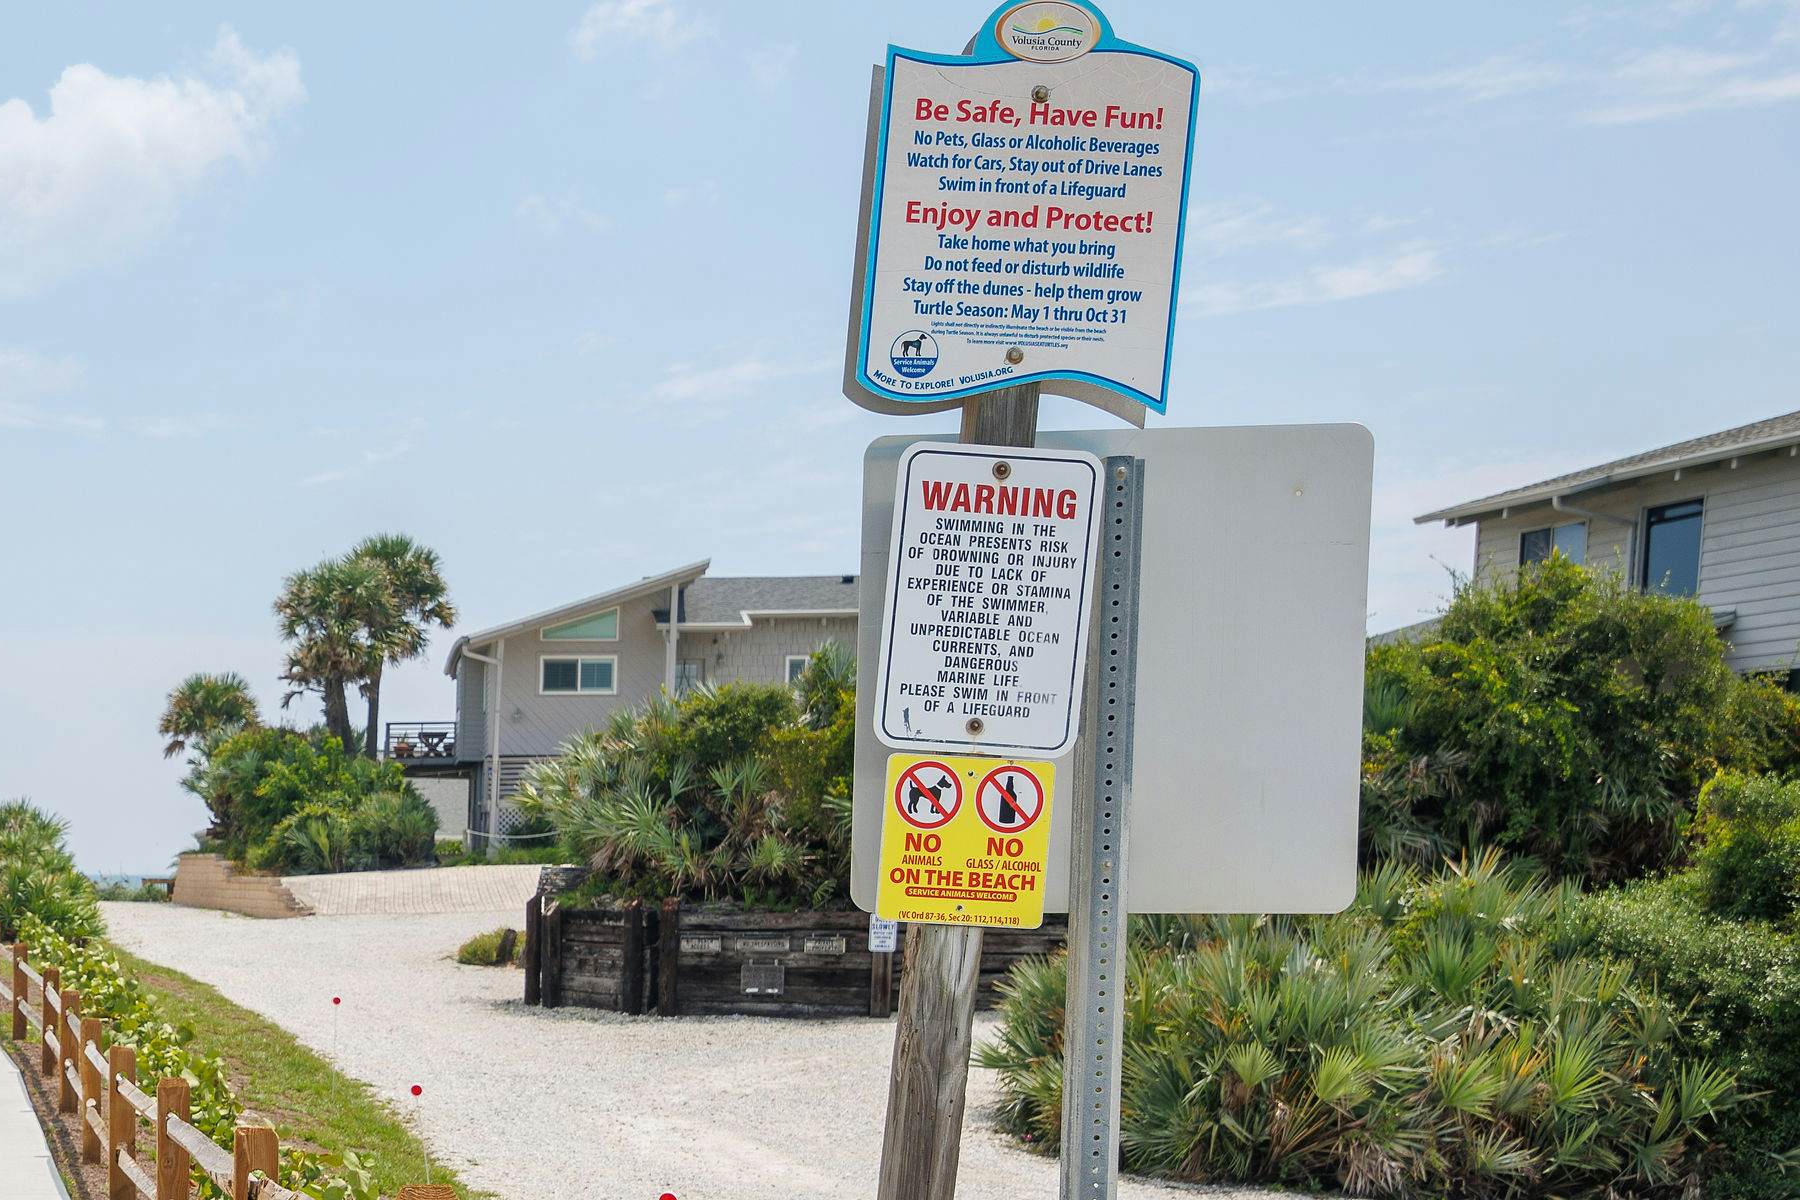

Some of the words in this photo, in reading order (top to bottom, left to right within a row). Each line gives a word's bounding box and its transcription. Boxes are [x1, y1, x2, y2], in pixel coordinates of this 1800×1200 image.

[1012, 36, 1045, 45] Volusia
[1048, 37, 1082, 51] County
[916, 98, 949, 121] Be
[956, 100, 1021, 127] Safe,
[1029, 102, 1097, 128] Have
[1105, 106, 1163, 129] Fun!
[915, 131, 932, 145] No
[936, 131, 968, 149] Pets,
[972, 133, 1005, 148] Glass
[1009, 138, 1023, 148] or
[1025, 135, 1086, 151] Alcoholic
[1089, 137, 1159, 157] Beverages
[908, 153, 948, 168] Watch
[952, 154, 972, 169] for
[974, 155, 1005, 173] Cars,
[1009, 157, 1039, 175] Stay
[1042, 160, 1065, 173] out
[1068, 159, 1083, 173] of
[1085, 160, 1120, 175] Drive
[1123, 161, 1162, 177] Lanes
[939, 176, 975, 191] Swim
[979, 177, 992, 192] in
[995, 178, 1030, 194] front
[1033, 180, 1048, 194] of
[1049, 184, 1057, 195] a
[1061, 181, 1126, 200] Lifeguard
[906, 201, 981, 232] Enjoy
[987, 205, 1039, 228] and
[1046, 207, 1153, 233] Protect!
[938, 234, 968, 249] Take
[972, 235, 1010, 251] home
[1014, 238, 1049, 253] what
[1051, 243, 1076, 257] you
[1079, 240, 1115, 259] bring
[925, 256, 942, 270] Do
[945, 259, 969, 271] not
[972, 257, 1002, 273] feed
[1005, 263, 1019, 273] or
[1022, 260, 1070, 276] disturb
[1073, 263, 1124, 278] wildlife
[903, 277, 932, 296] Stay
[936, 279, 955, 293] off
[957, 279, 979, 294] the
[983, 281, 1023, 296] dunes
[1035, 283, 1064, 302] help
[1068, 284, 1103, 300] them
[1107, 290, 1142, 304] grow
[914, 300, 953, 315] Turtle
[956, 302, 1008, 318] Season:
[1011, 304, 1040, 323] May
[1044, 306, 1049, 320] 1
[1053, 306, 1082, 321] thru
[1086, 308, 1108, 322] Oct
[1110, 309, 1126, 323] 31
[900, 380, 912, 389] TO
[922, 481, 1076, 519] WARNING
[936, 518, 1003, 534] SWIMMING
[1012, 523, 1024, 535] IN
[1033, 524, 1056, 537] THE
[920, 532, 961, 546] OCEAN
[969, 536, 1031, 551] PRESENTS
[1040, 541, 1068, 553] RISK
[908, 547, 924, 559] OF
[933, 548, 999, 564] DROWNING
[1008, 553, 1024, 565] OR
[1033, 555, 1077, 569] INJURY
[936, 564, 960, 577] DUE
[968, 566, 983, 578] TO
[991, 567, 1023, 581] LACK
[1031, 570, 1046, 582] OF
[908, 577, 983, 593] EXPERIENCE
[992, 583, 1008, 595] OR
[1017, 585, 1070, 599] STAMINA
[927, 594, 943, 606] OF
[951, 596, 974, 608] THE
[941, 610, 1000, 625] VARIABLE
[1008, 615, 1032, 627] AND
[911, 623, 1010, 641] UNPREDICTABLE
[1019, 630, 1059, 644] OCEAN
[933, 640, 1000, 658] CURRENTS,
[1009, 646, 1034, 657] AND
[945, 656, 1017, 672] DANGEROUS
[937, 671, 985, 685] MARINE
[900, 683, 945, 697] PLEASE
[953, 687, 988, 700] SWIM
[997, 690, 1008, 701] IN
[1017, 691, 1057, 704] FRONT
[924, 700, 940, 712] OF
[947, 702, 954, 713] A
[963, 703, 1030, 718] LIFEGUARD
[905, 833, 941, 853] NO
[987, 837, 1023, 857] NO
[902, 854, 942, 866] ANIMALS
[966, 859, 993, 869] GLASS
[1002, 860, 1041, 872] ALCOHOL
[890, 868, 920, 884] ON
[925, 870, 963, 887] THE
[968, 872, 1035, 891] BEACH
[908, 888, 940, 897] SERVICE
[941, 890, 975, 898] ANIMALS
[976, 891, 1014, 900] WELCOME
[899, 911, 911, 919] (VC
[925, 912, 946, 922] 87-36,
[961, 914, 972, 922] 20:
